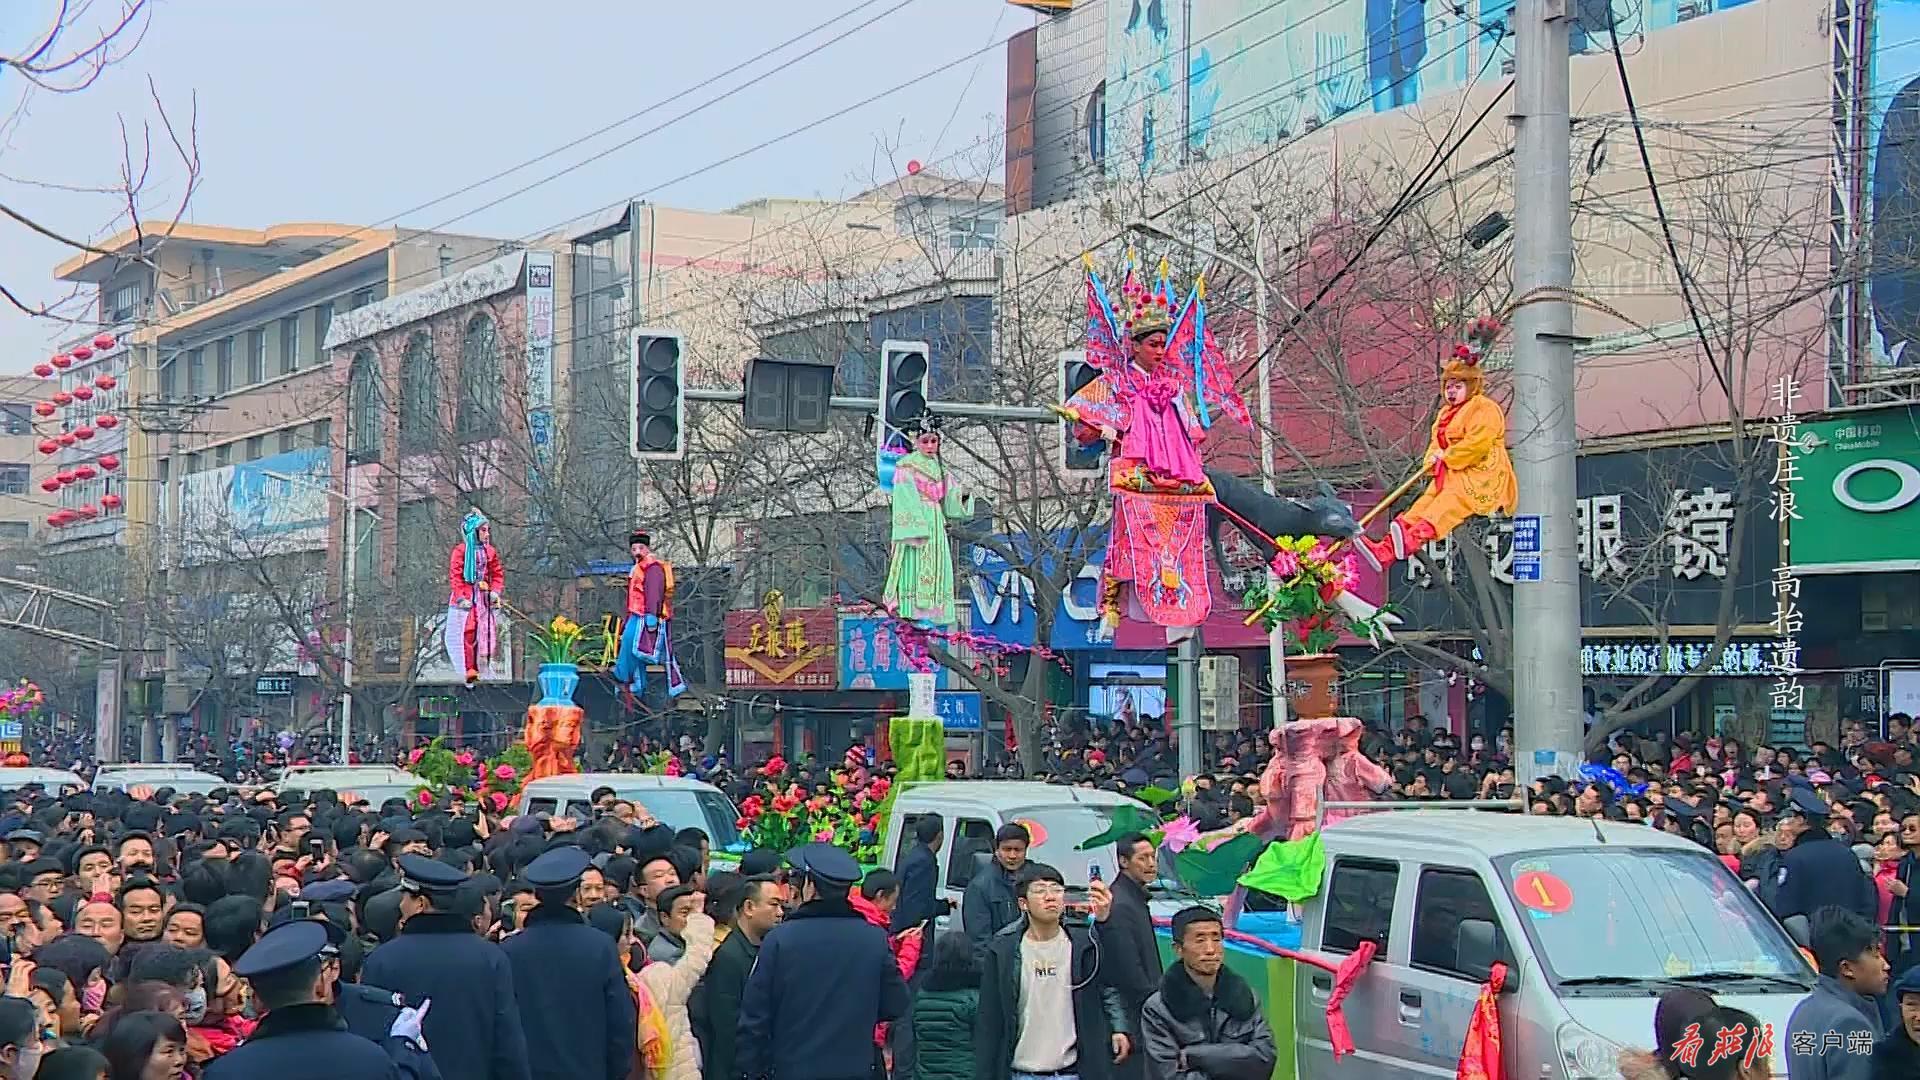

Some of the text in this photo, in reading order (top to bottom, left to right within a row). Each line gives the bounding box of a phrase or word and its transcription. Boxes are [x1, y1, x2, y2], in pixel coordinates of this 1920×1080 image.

[1834, 424, 1882, 439] 中国移动
[1531, 876, 1556, 906] 1
